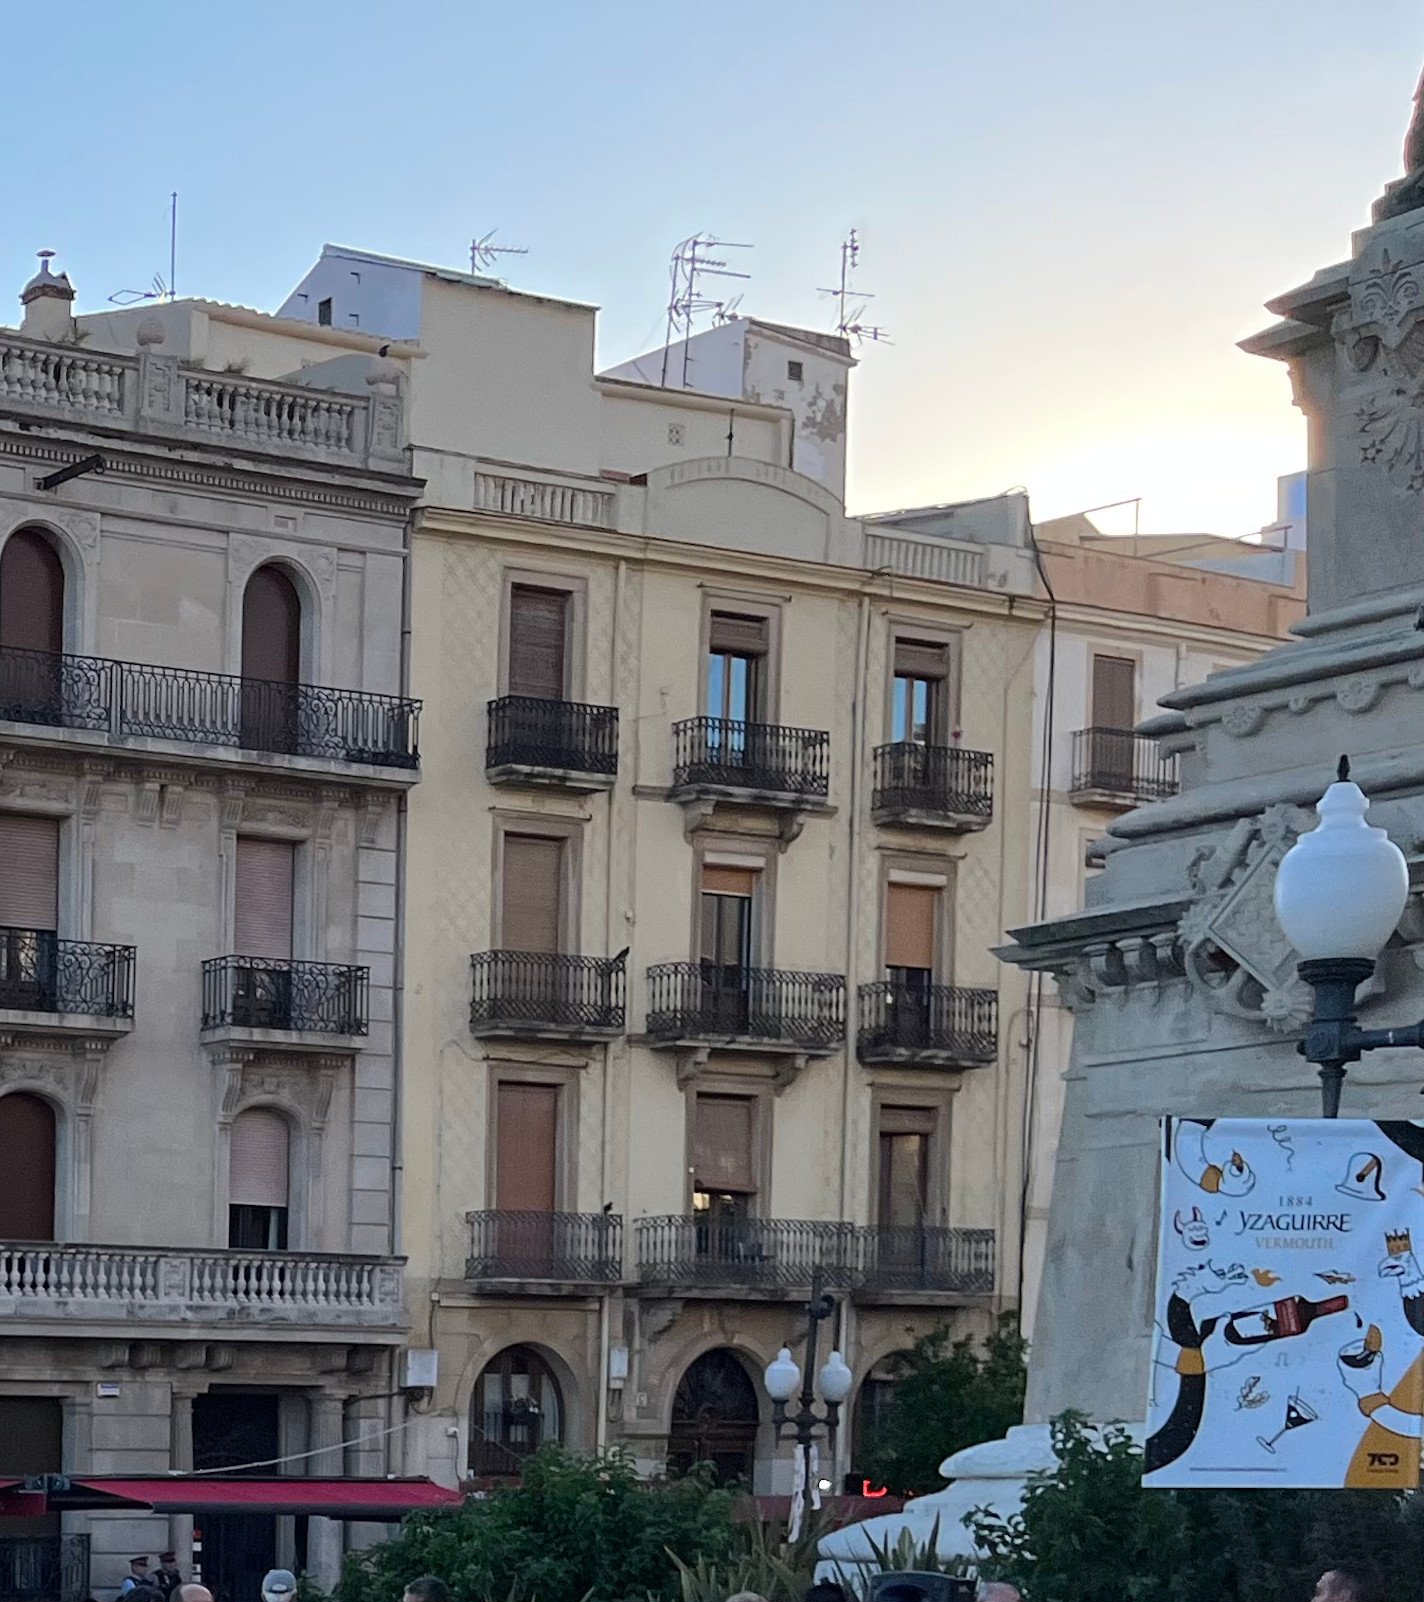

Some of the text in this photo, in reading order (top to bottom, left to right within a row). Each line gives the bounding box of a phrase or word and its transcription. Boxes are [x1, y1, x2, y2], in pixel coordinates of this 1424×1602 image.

[1279, 1195, 1313, 1207] 1884
[1234, 1210, 1354, 1236] YZAGUIRRE
[1255, 1237, 1334, 1249] VERMOUTH
